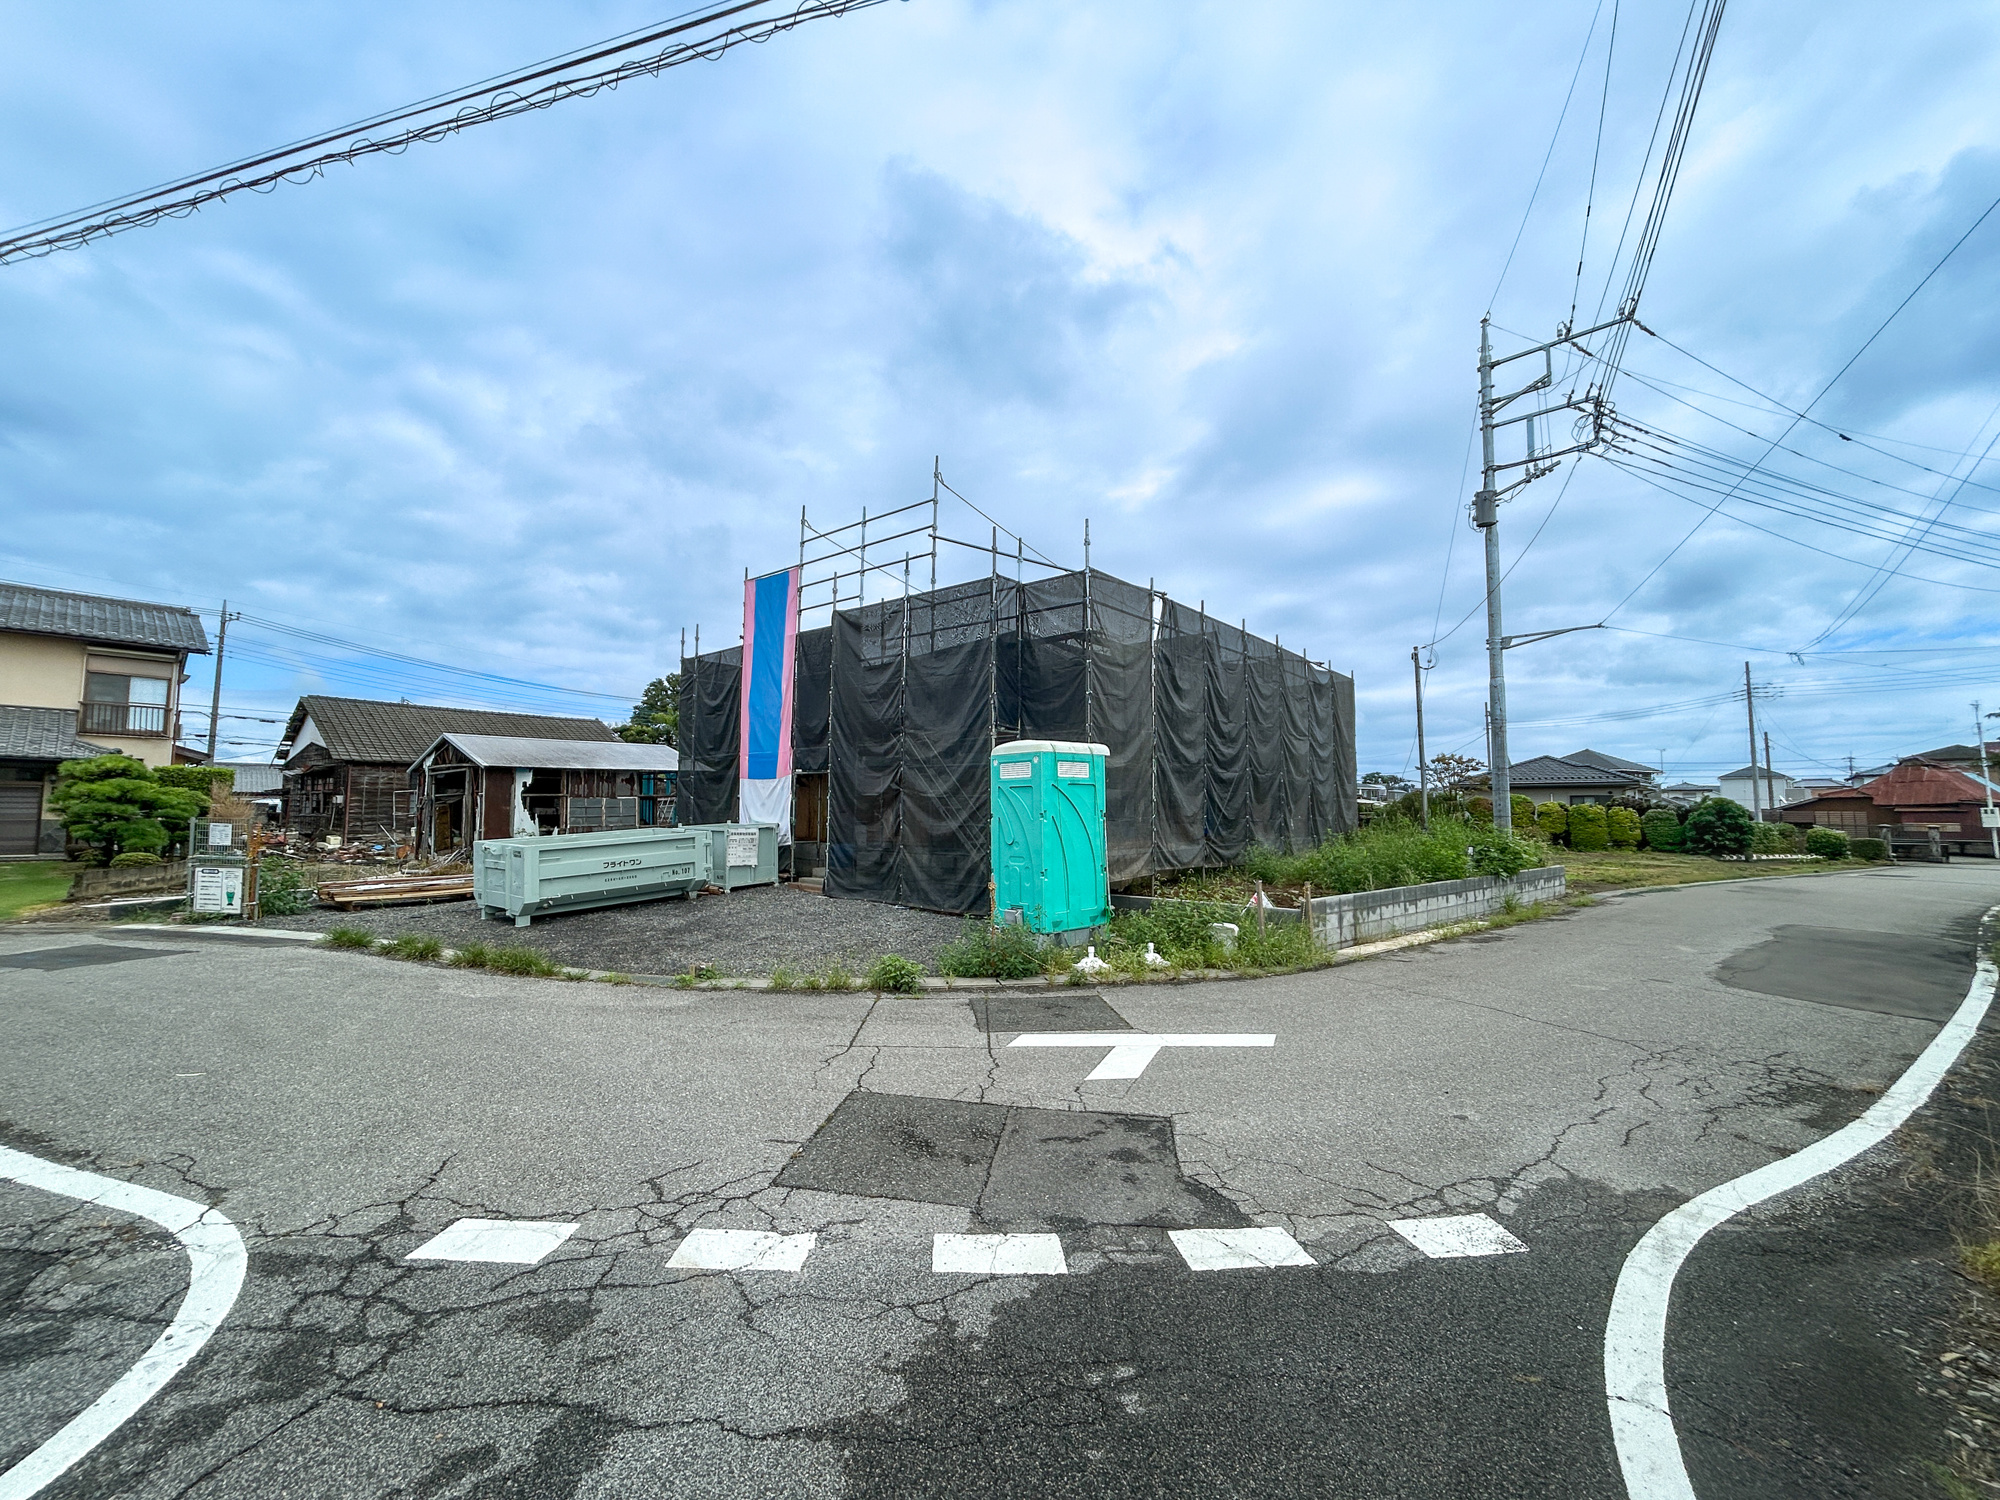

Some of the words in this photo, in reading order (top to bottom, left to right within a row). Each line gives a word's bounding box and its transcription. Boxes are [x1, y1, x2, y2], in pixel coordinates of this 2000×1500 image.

[603, 859, 642, 868] フライトワン
